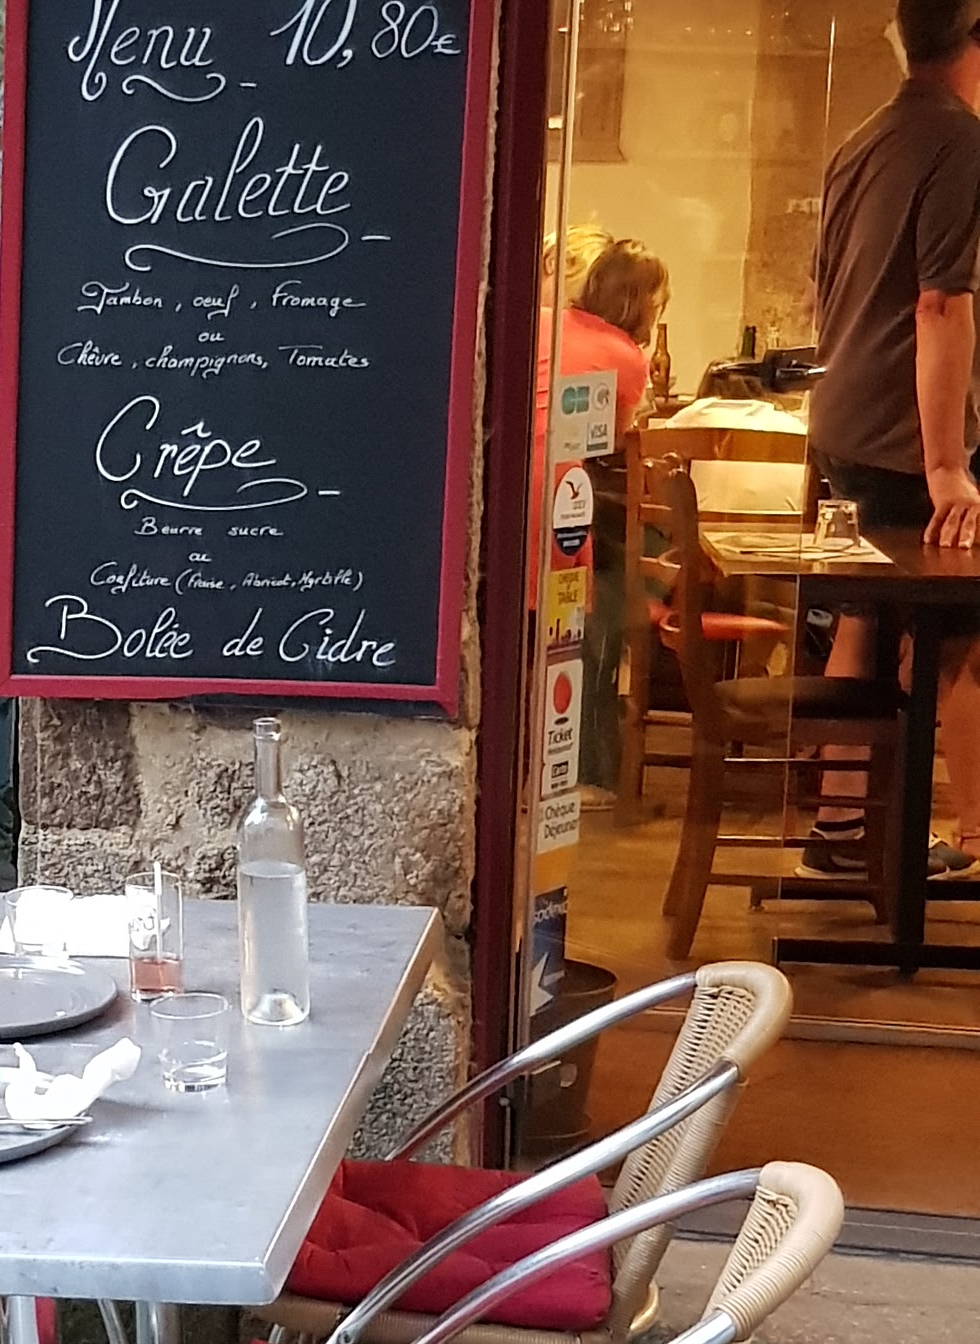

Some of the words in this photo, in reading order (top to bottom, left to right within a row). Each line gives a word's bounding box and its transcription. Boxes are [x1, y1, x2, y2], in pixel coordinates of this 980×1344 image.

[106, 117, 350, 228] Galette
[273, 280, 366, 316] Fromage
[199, 332, 224, 342] ou
[279, 346, 369, 367] Tomates
[96, 396, 278, 498] Crêpe
[135, 517, 202, 535] Beurre
[228, 526, 283, 536] sucre
[91, 562, 171, 594] Confiture
[27, 593, 193, 663] Bolée
[223, 608, 263, 656] de
[279, 609, 395, 666] Cidre
[547, 727, 574, 747] Ticket
